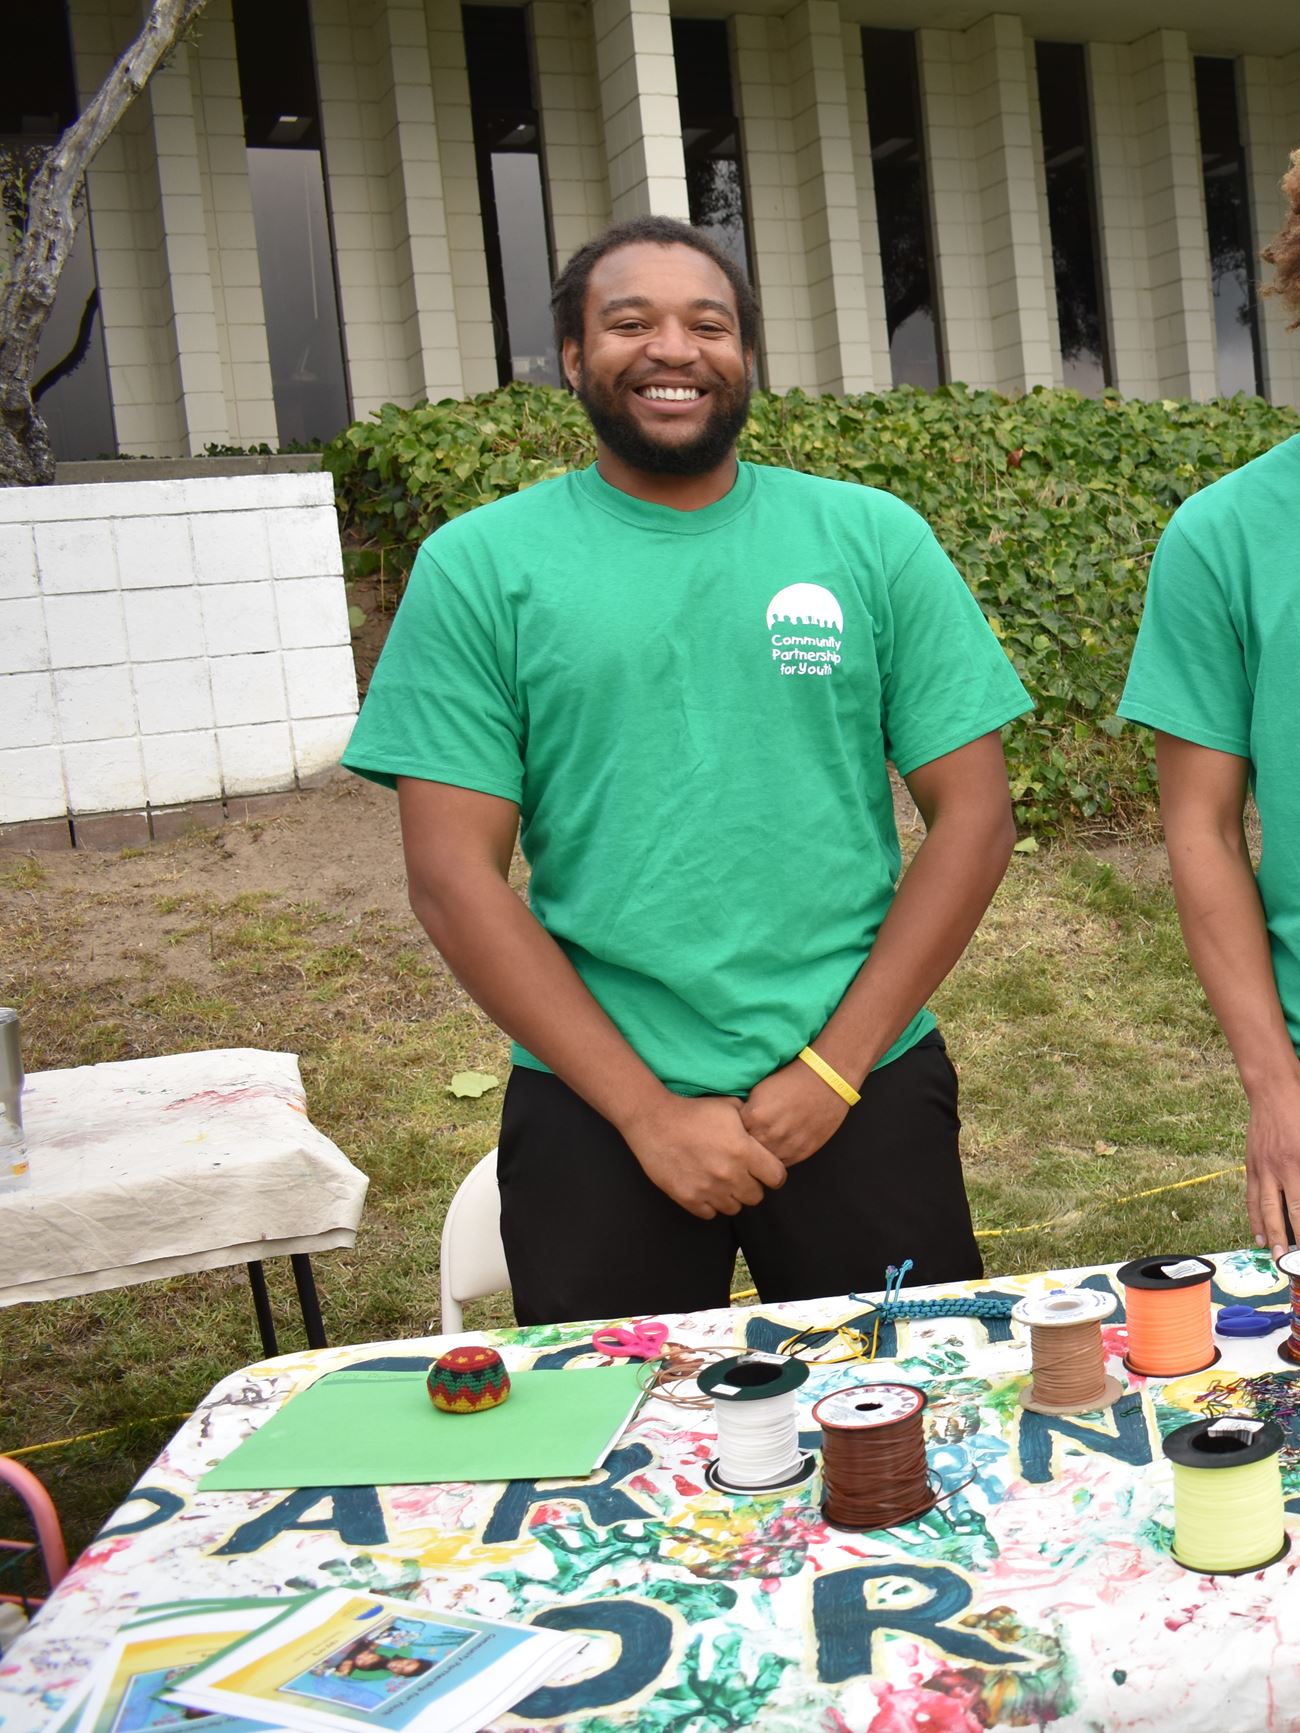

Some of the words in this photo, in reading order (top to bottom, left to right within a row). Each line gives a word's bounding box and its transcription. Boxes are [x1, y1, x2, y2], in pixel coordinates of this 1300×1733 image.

[771, 634, 842, 651] Community
[771, 648, 841, 666] Partnership
[780, 662, 796, 675] for
[797, 662, 832, 676] Youth
